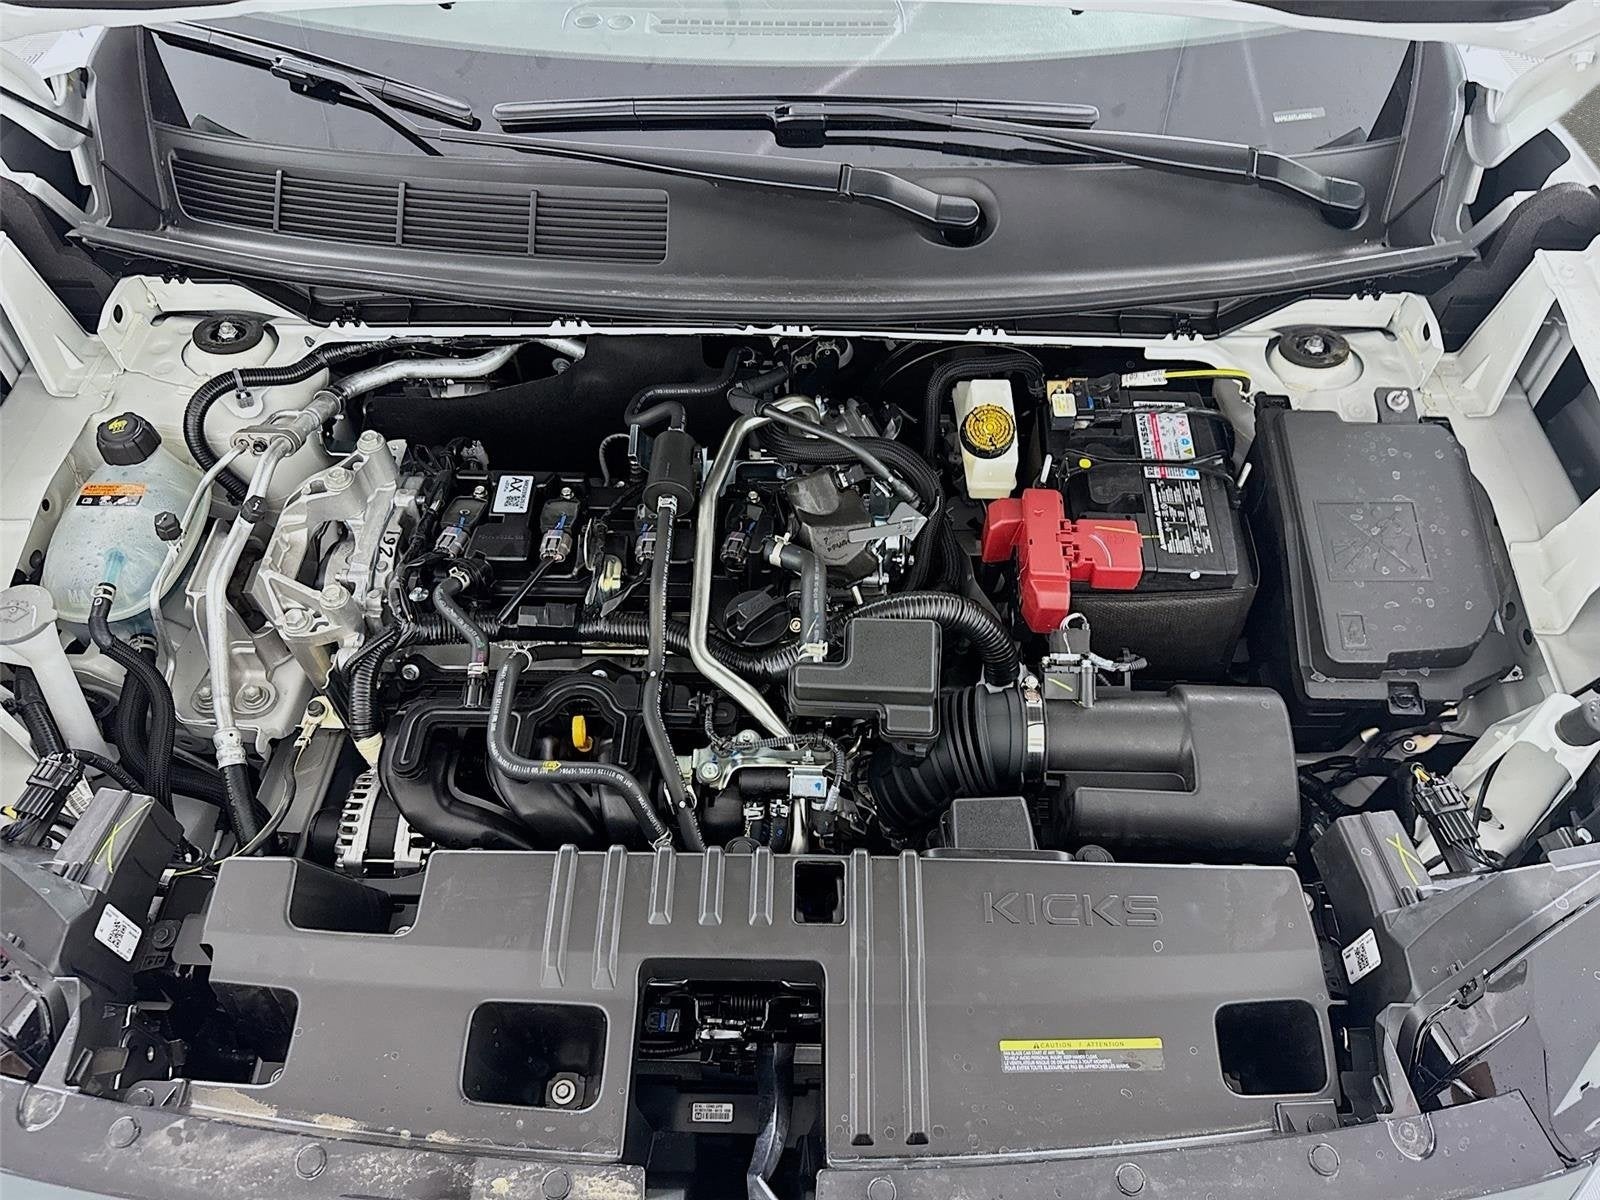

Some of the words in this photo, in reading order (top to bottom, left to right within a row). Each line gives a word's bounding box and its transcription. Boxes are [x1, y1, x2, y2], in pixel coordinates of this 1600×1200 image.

[509, 476, 524, 493] AX
[379, 530, 401, 559] 192
[983, 892, 1164, 927] KICKS
[1086, 1040, 1125, 1048] ATTENTION
